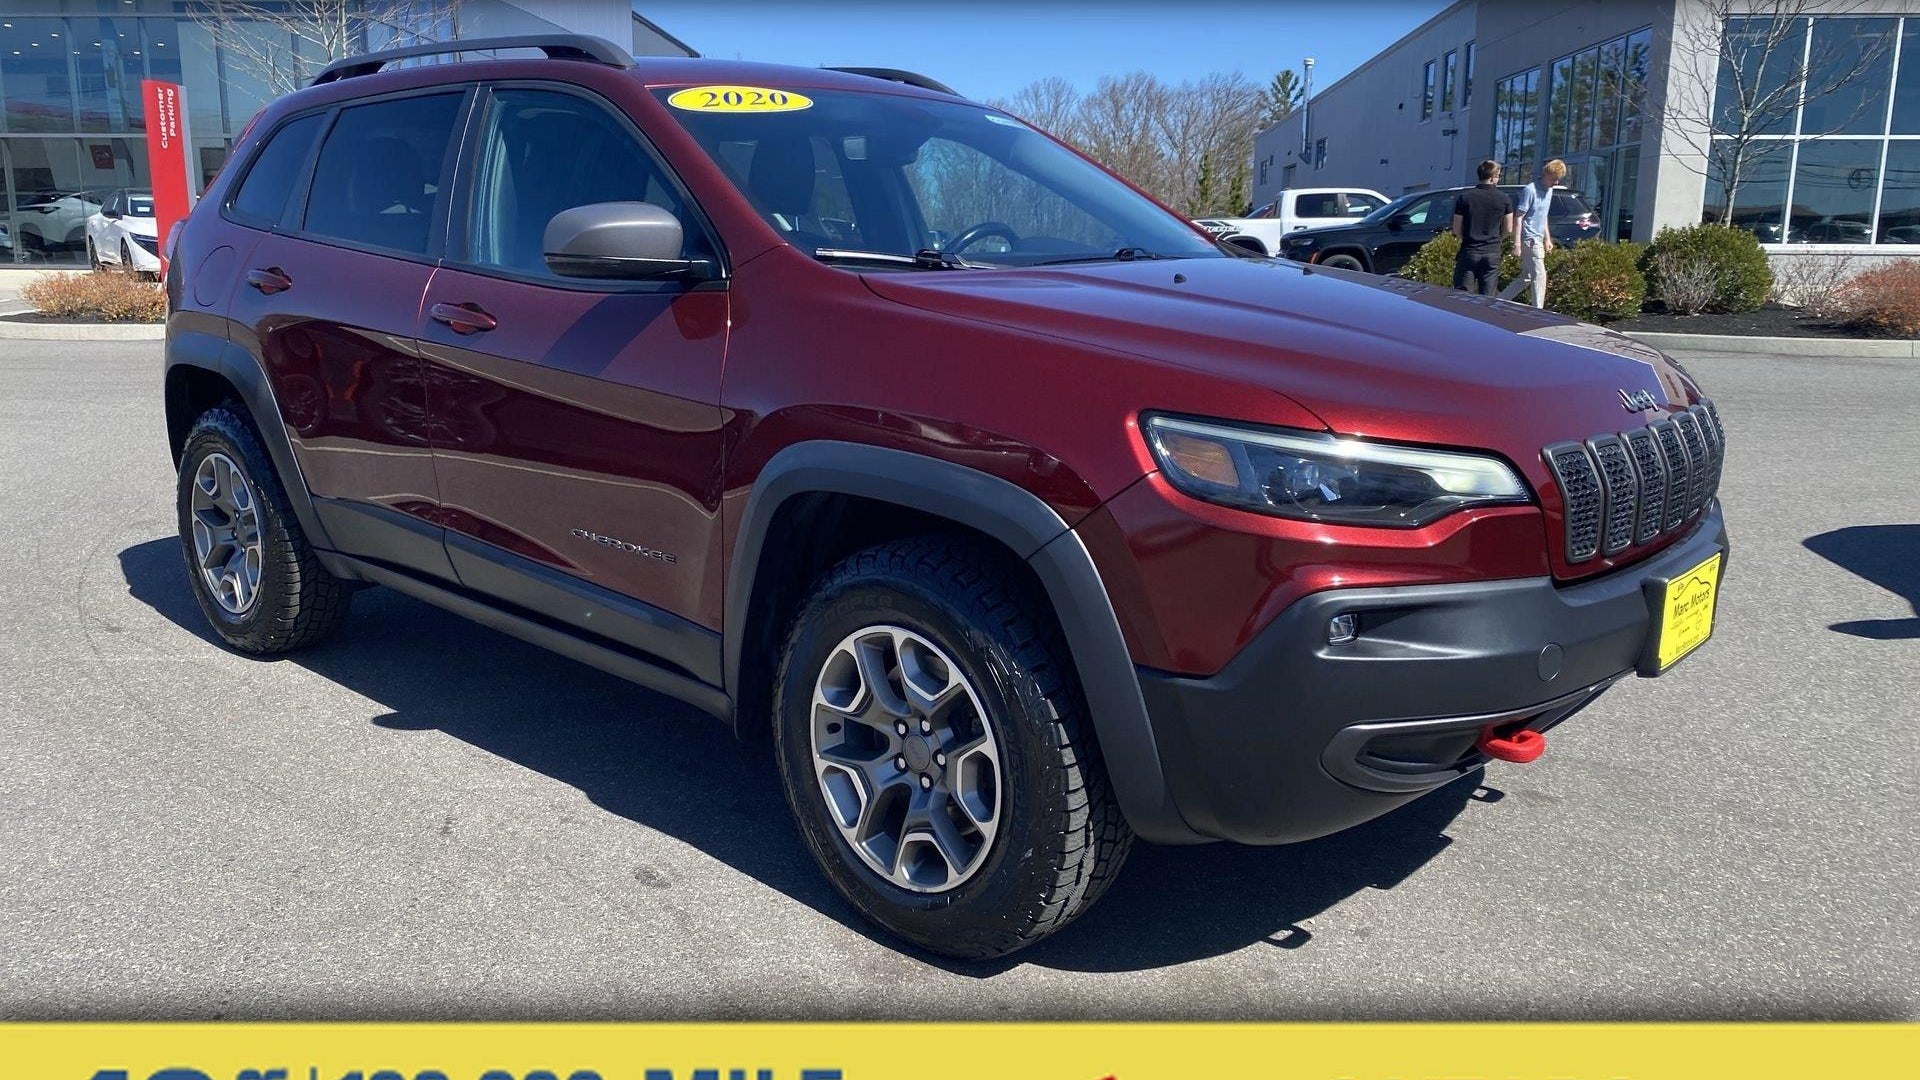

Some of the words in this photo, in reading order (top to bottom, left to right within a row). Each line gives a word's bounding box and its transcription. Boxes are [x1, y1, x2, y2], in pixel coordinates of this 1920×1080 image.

[157, 86, 168, 149] Customer
[166, 88, 176, 137] Parking
[699, 90, 788, 108] 2020
[571, 527, 680, 565] CHEROKEE
[1673, 601, 1690, 619] Marc
